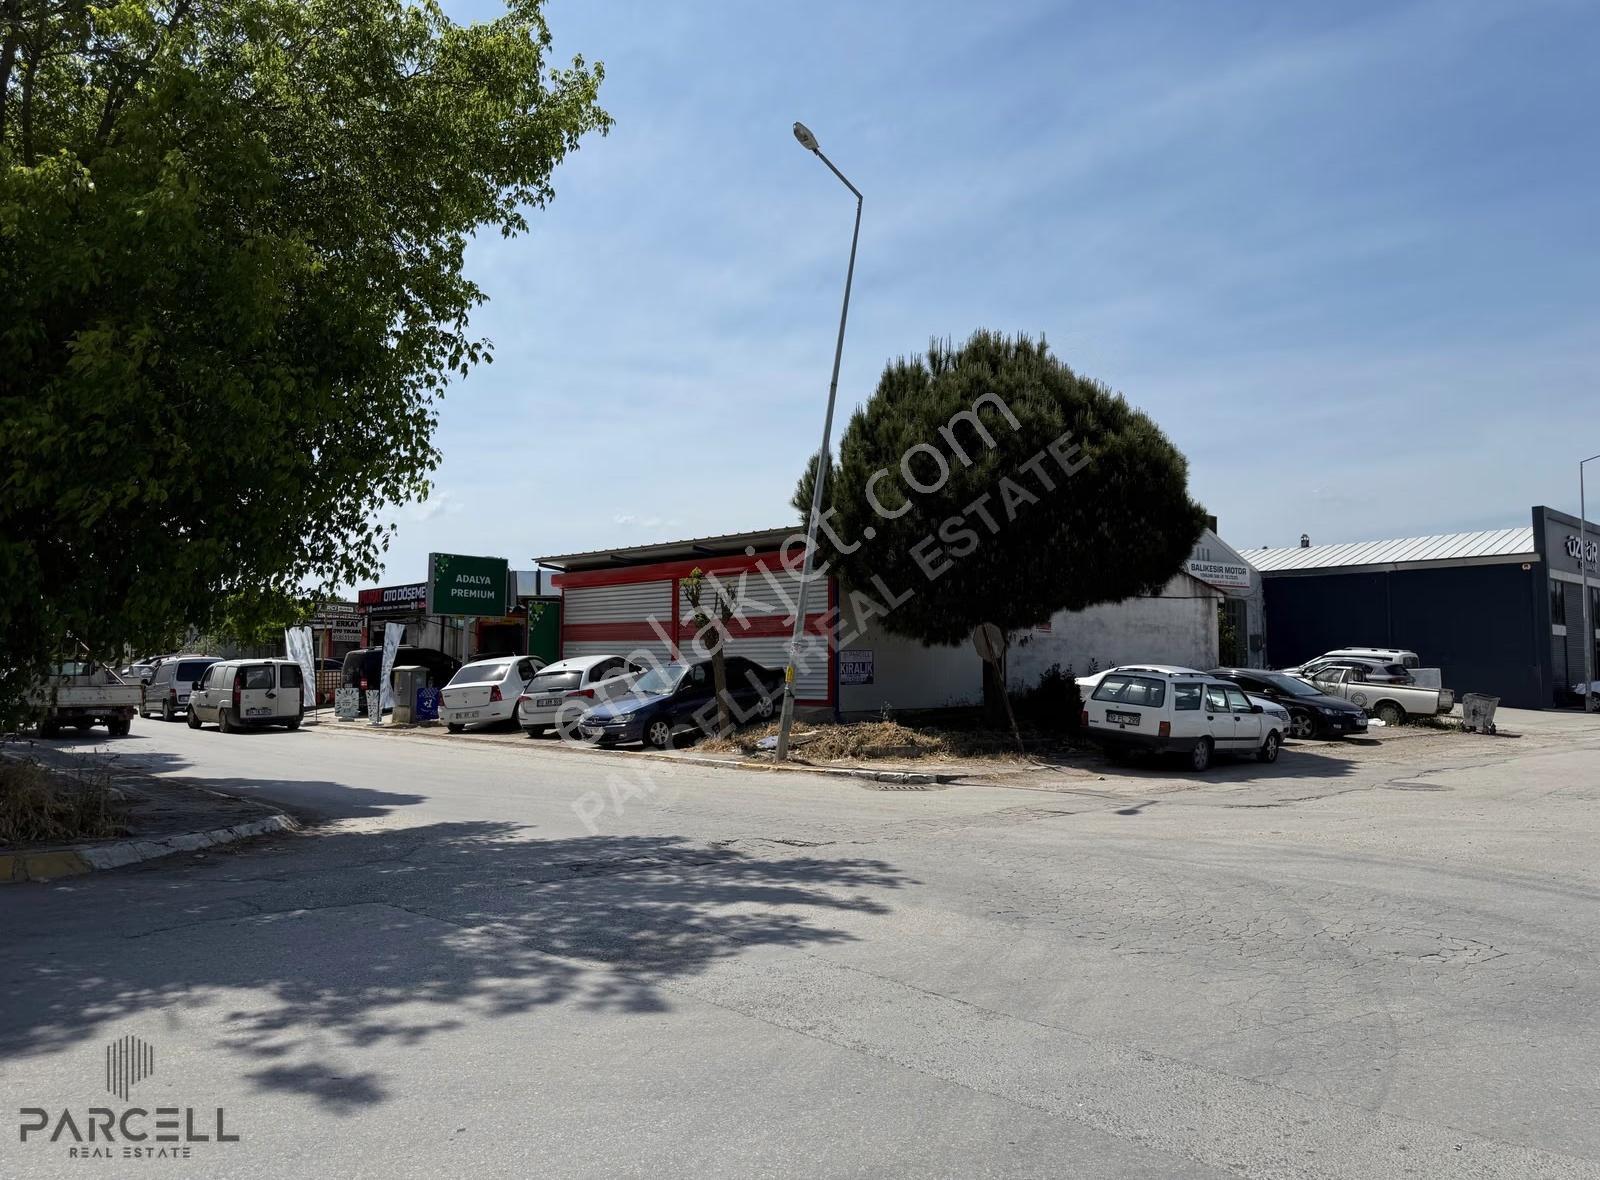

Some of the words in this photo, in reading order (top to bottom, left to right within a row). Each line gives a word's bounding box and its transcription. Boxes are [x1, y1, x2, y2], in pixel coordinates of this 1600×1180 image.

[455, 574, 491, 584] ADALYA
[383, 590, 396, 602] OTO
[451, 588, 495, 599] PREMIUM
[335, 620, 359, 628] ERKAY
